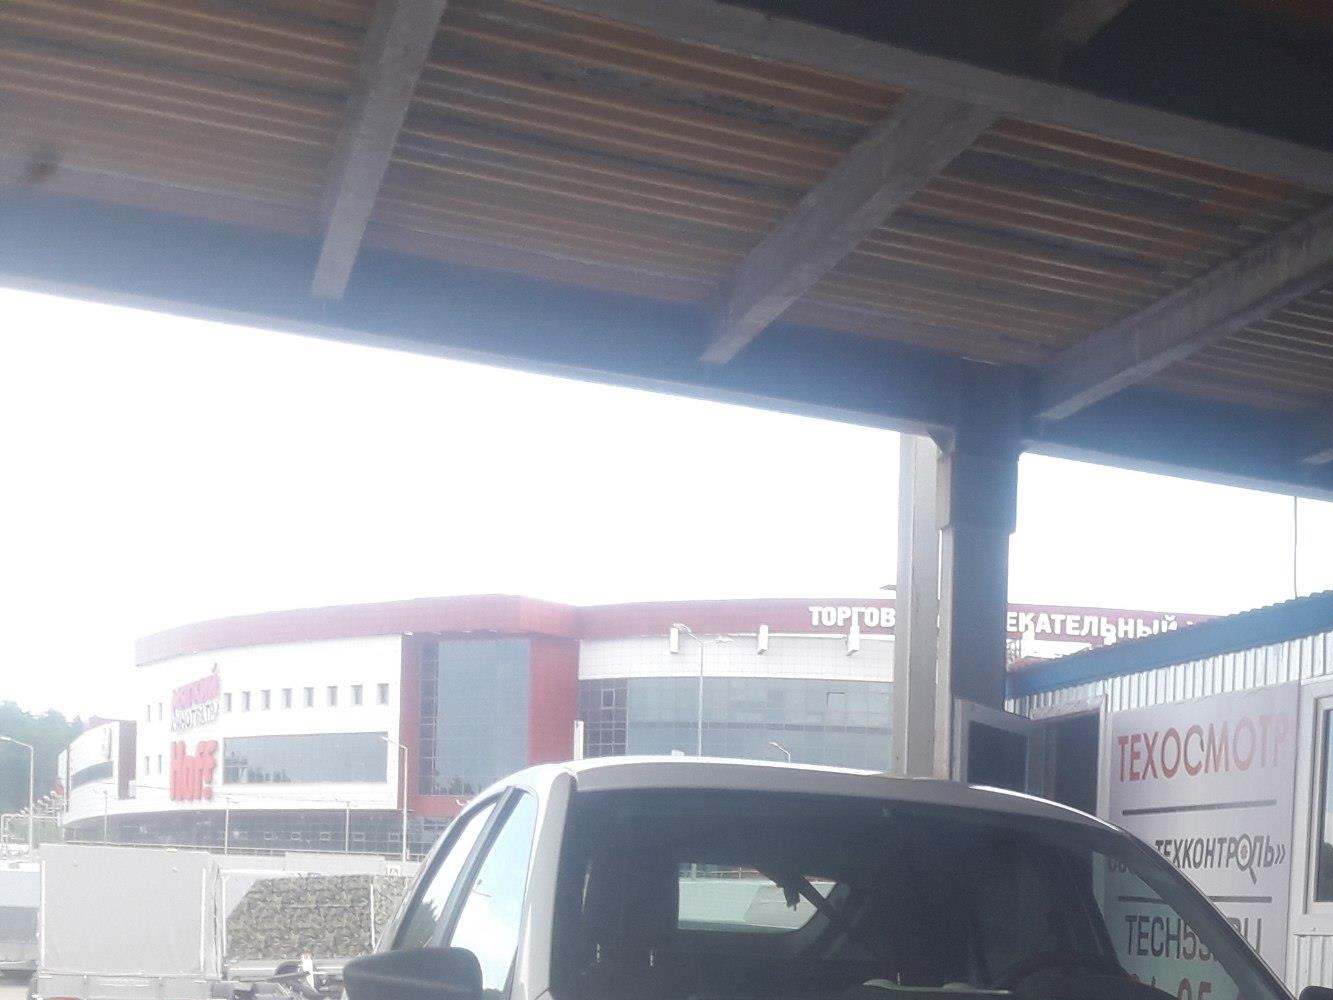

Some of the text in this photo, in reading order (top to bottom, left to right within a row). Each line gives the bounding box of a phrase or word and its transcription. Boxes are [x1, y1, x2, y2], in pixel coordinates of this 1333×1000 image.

[808, 605, 1178, 639] ТОРГОВ ЕКАТЕЛЬНЫЙ
[1117, 715, 1288, 782] ТЕХОСМОТР
[1154, 833, 1286, 884] ТЕХКОНТРОЛЬ»
